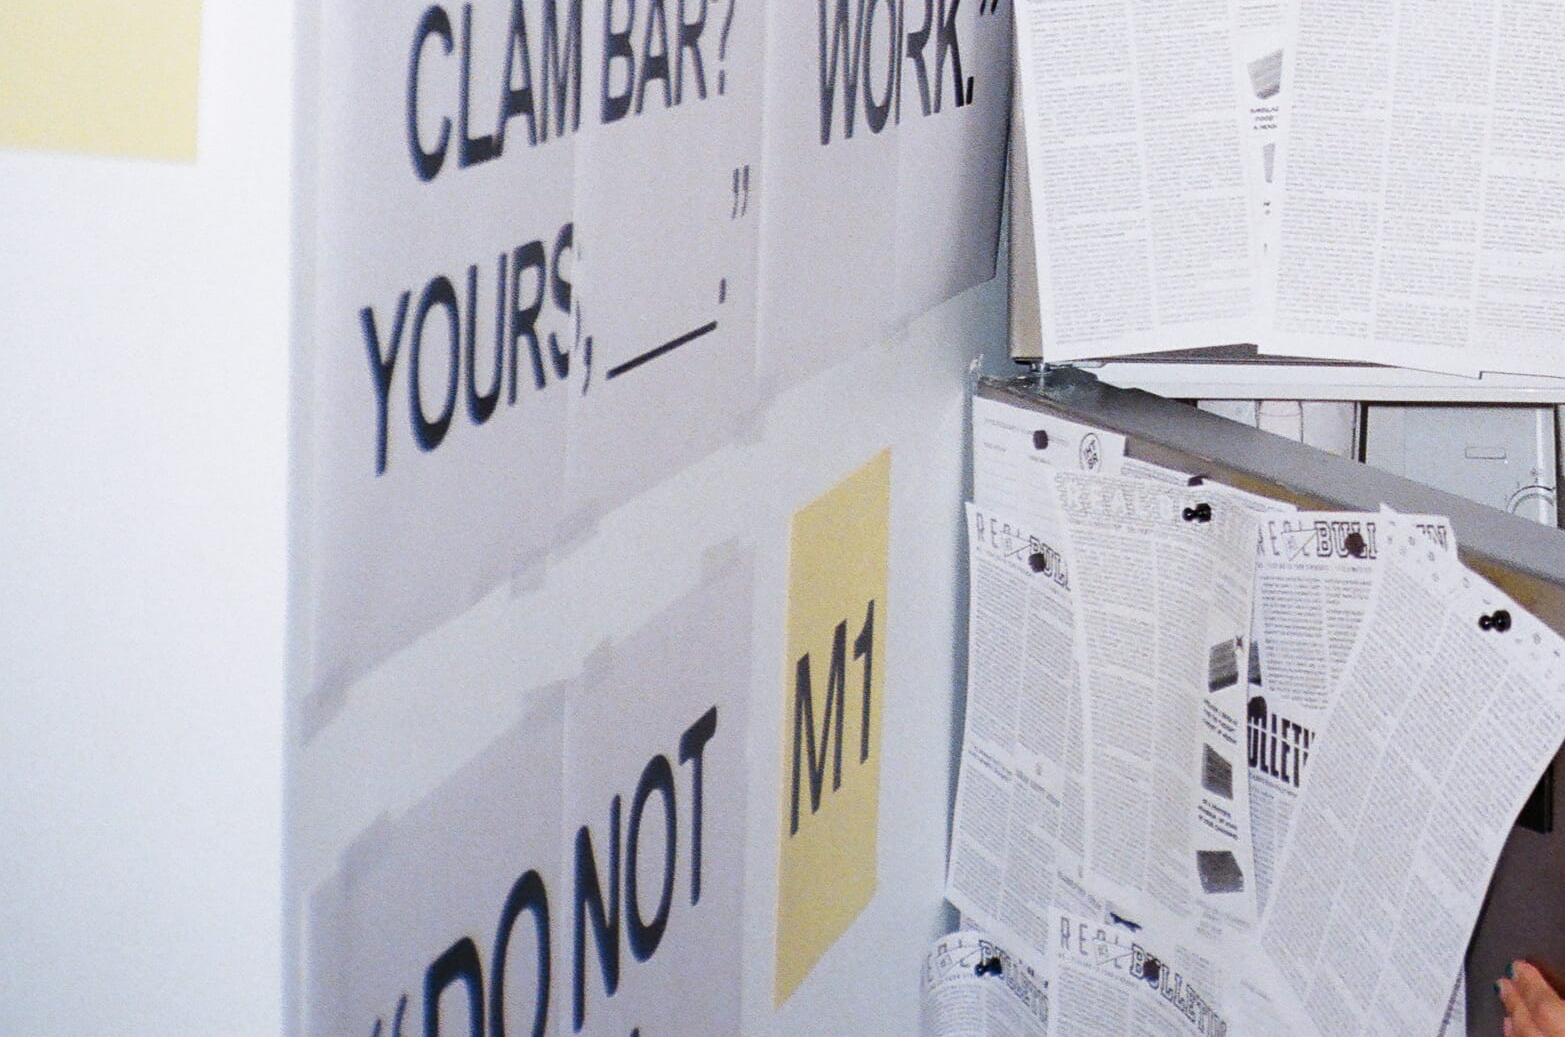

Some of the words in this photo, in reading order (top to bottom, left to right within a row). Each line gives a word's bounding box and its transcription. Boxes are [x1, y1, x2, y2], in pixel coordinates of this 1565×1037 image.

[790, 599, 875, 838] M1
[372, 869, 552, 1037] “O
[573, 705, 717, 1034] NOT
